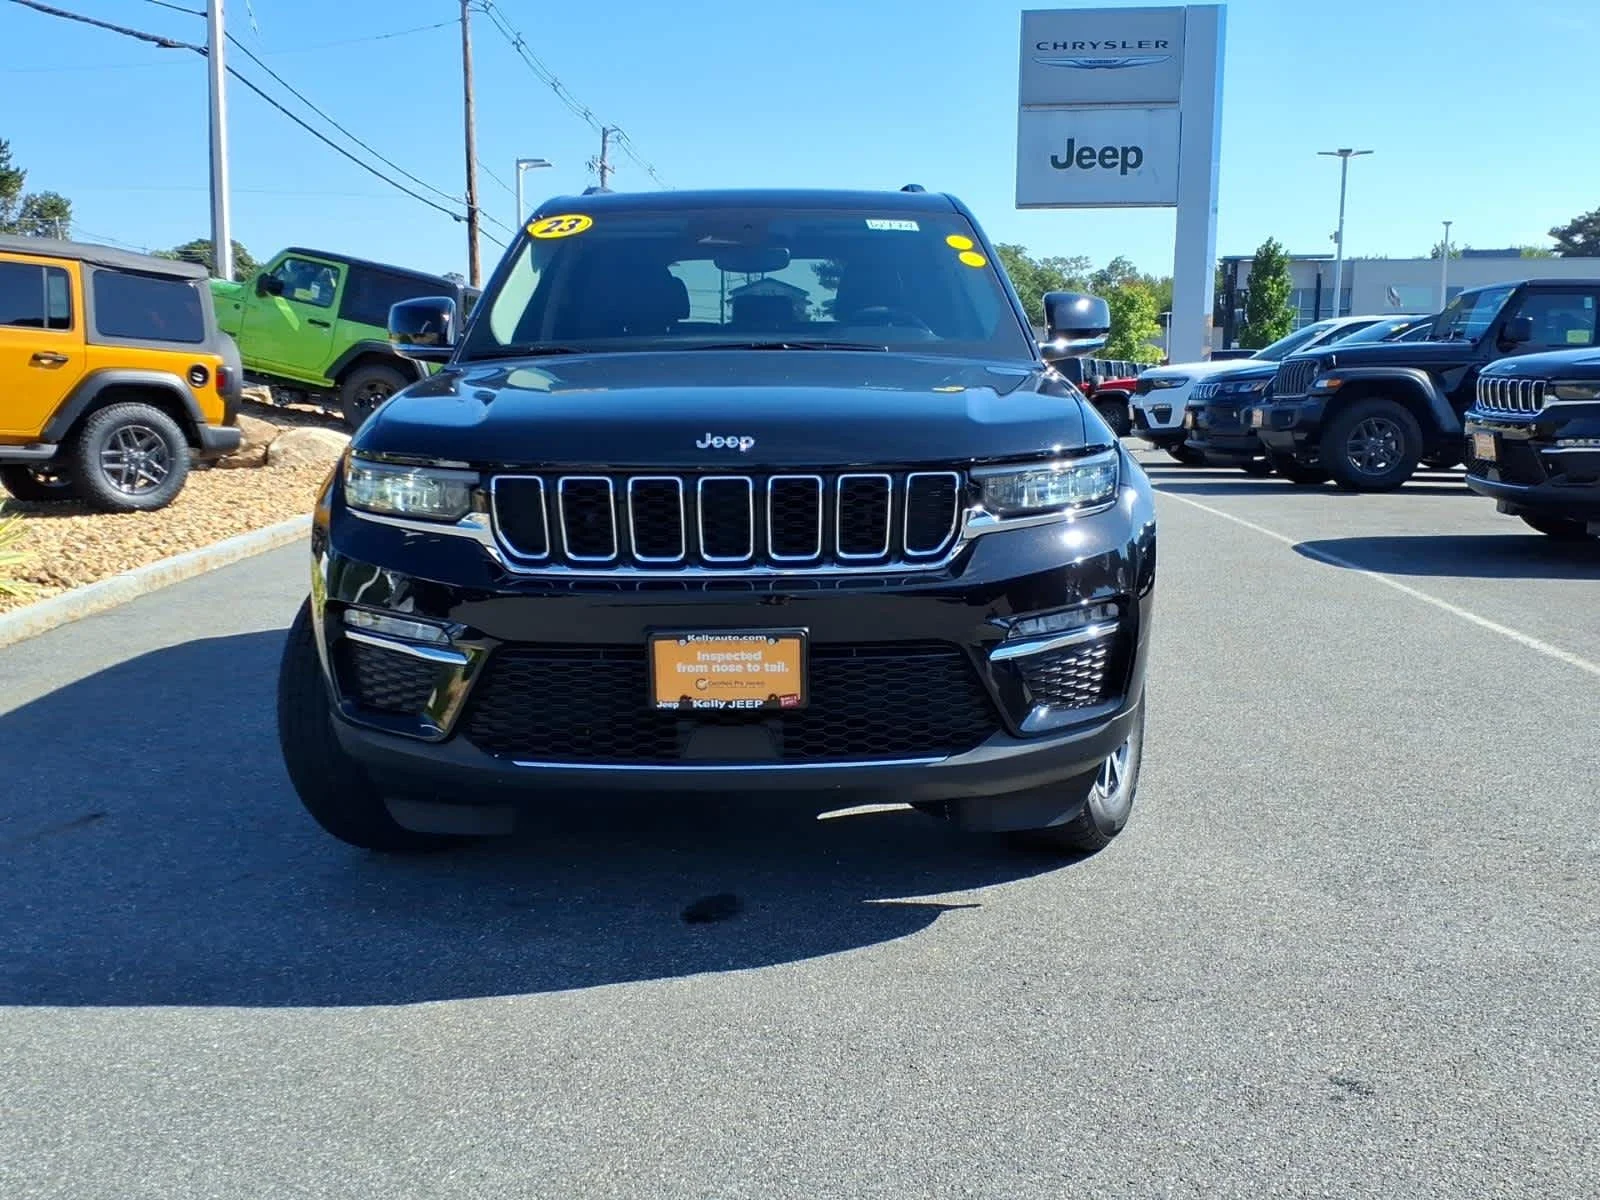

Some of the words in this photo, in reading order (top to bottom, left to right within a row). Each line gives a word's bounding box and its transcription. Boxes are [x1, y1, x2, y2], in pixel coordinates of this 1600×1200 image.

[1035, 40, 1169, 50] CHRYSLER
[1050, 137, 1144, 175] Jeep
[538, 218, 582, 234] 23
[696, 432, 754, 451] Jeep
[687, 634, 766, 642] Kellyauto.com
[696, 651, 762, 663] Inspected
[676, 663, 708, 673] from
[712, 664, 744, 673] nose
[747, 663, 760, 672] to
[764, 662, 789, 672] tail.
[656, 701, 680, 709] Jeep
[692, 700, 726, 709] Kelly
[728, 700, 763, 709] JEEP
